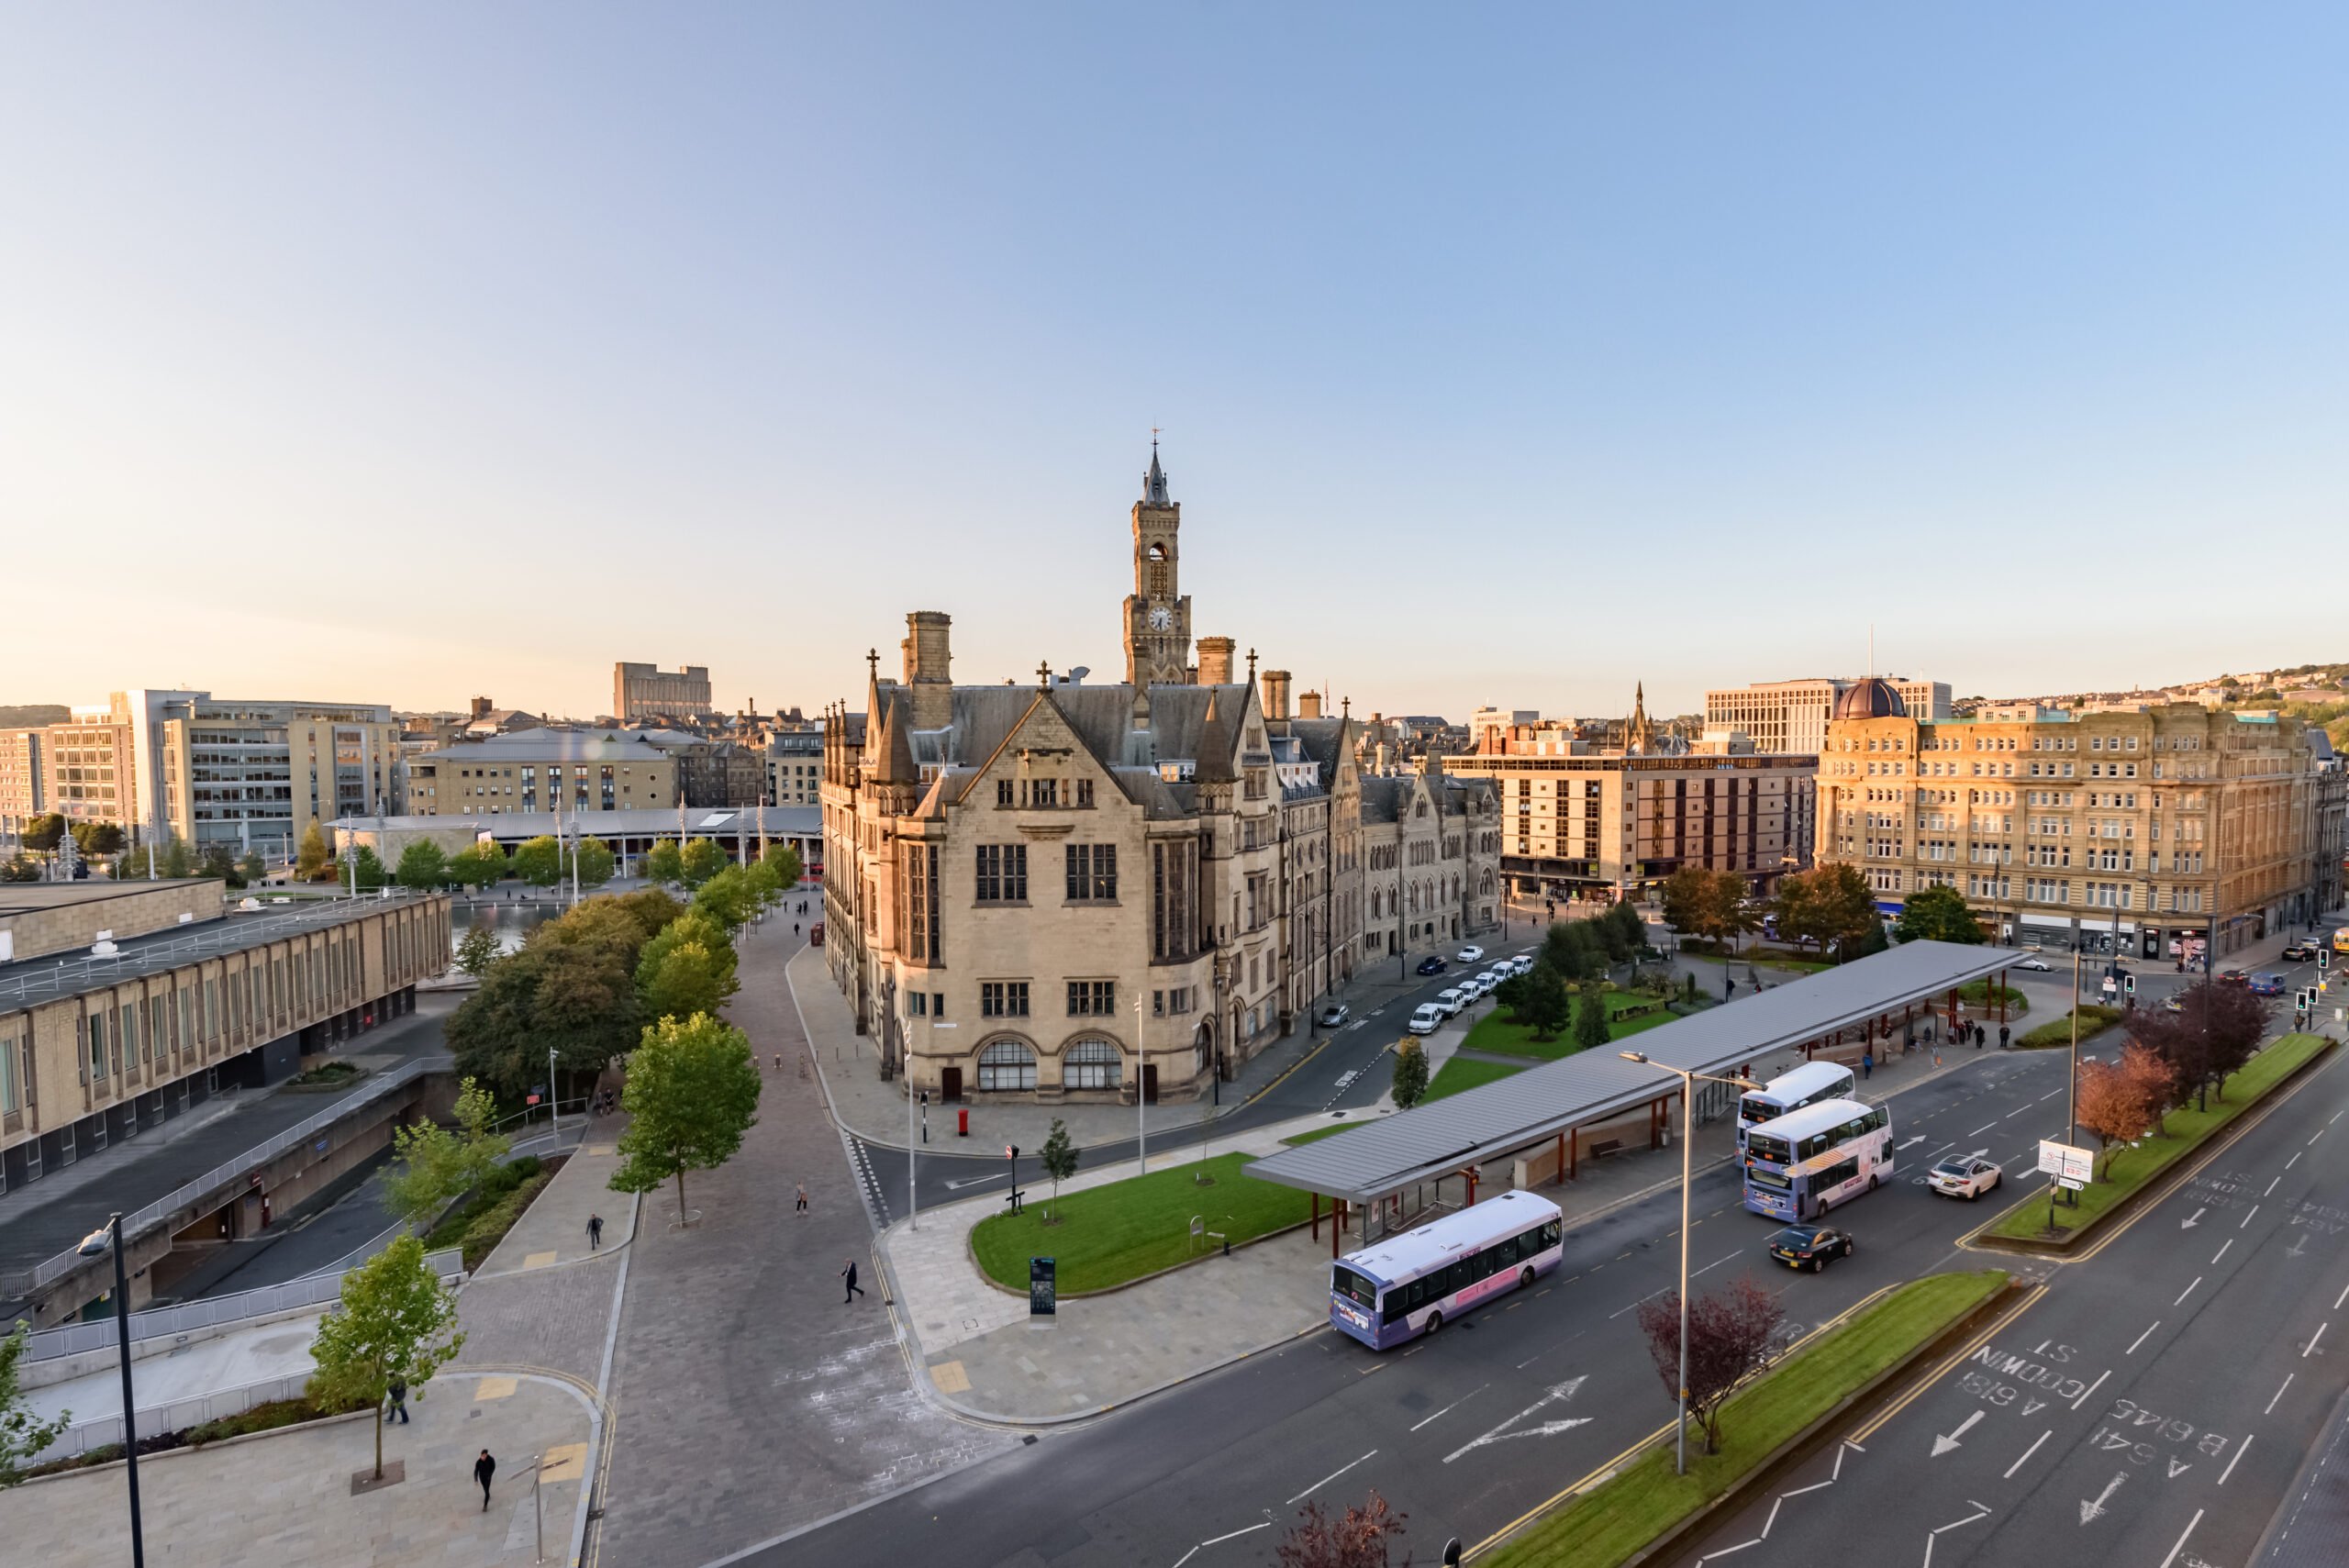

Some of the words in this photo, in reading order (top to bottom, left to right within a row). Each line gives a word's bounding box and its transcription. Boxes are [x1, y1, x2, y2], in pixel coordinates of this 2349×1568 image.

[2025, 1339, 2078, 1363] ST
[1970, 1345, 2086, 1398] GODWIN
[1954, 1371, 2019, 1407] 6181
[2021, 1395, 2048, 1416] A
[2108, 1398, 2195, 1442] 6145
[2089, 1426, 2157, 1466] 641
[2197, 1432, 2229, 1458] B
[2167, 1454, 2193, 1478] A
